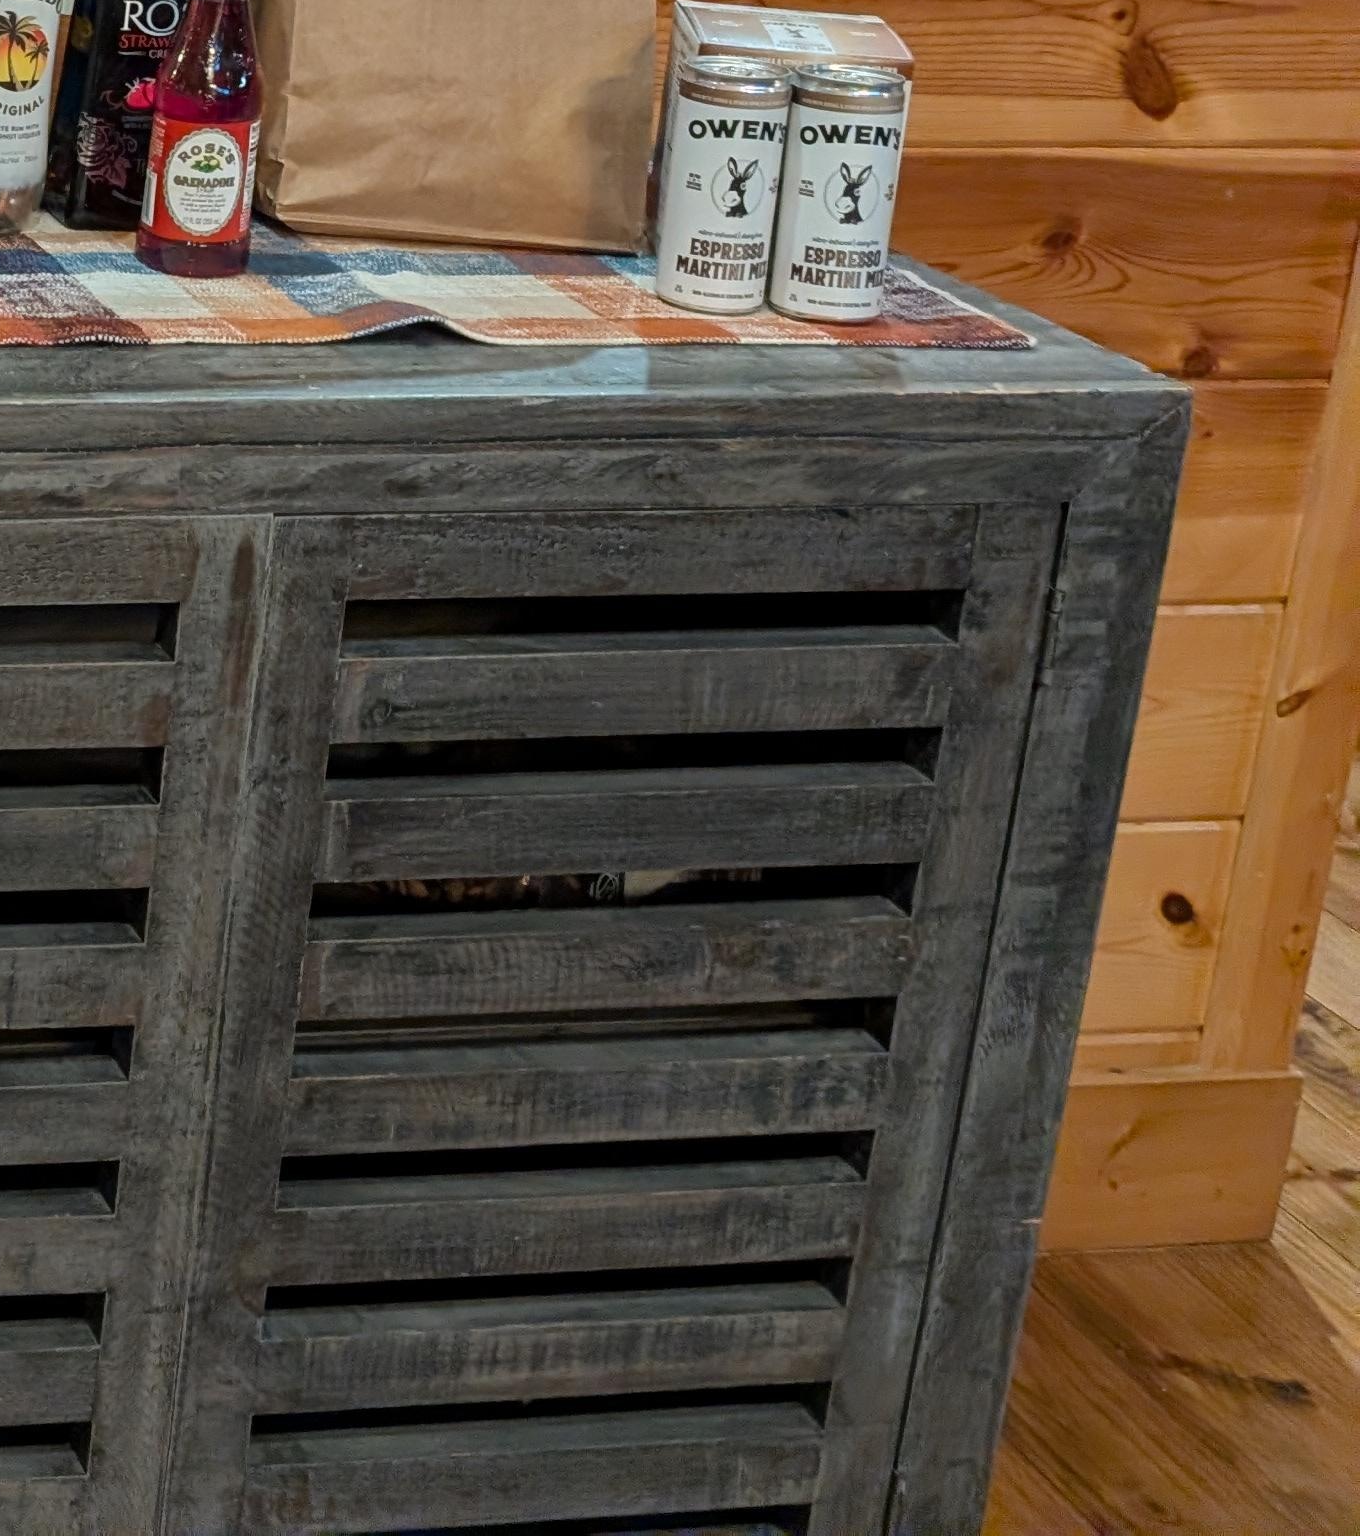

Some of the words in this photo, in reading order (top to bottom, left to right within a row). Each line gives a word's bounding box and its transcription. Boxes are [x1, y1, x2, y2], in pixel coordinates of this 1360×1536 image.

[178, 143, 235, 165] ROSE'S
[173, 175, 236, 188] GRENADINE
[690, 237, 765, 261] ESPRESSO
[804, 245, 882, 268] ESPRESSO
[675, 254, 745, 281] MARTINI
[790, 263, 861, 289] MARTINI
